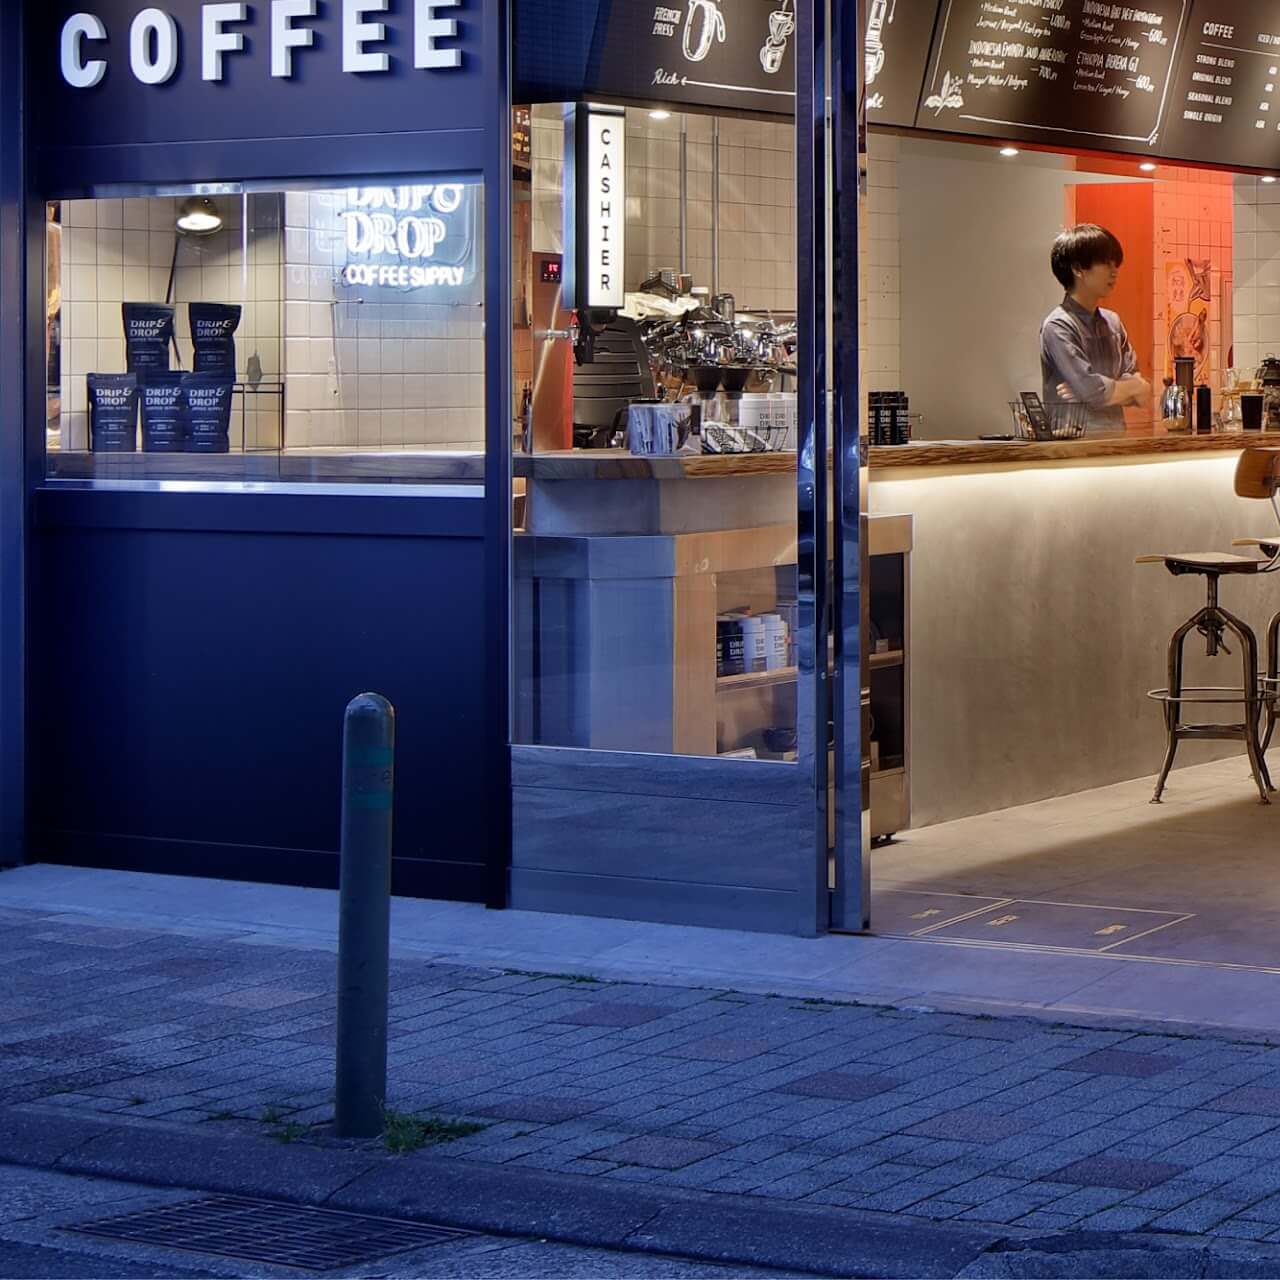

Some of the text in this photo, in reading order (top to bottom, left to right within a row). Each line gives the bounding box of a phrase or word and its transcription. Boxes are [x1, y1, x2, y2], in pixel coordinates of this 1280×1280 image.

[653, 6, 683, 25] FRENCH
[652, 22, 675, 37] PRESS
[1203, 22, 1235, 39] COFFEE
[651, 68, 681, 87] Rich
[600, 128, 612, 291] CASHIER
[342, 211, 447, 258] DROP
[345, 263, 409, 287] COFFEE
[129, 328, 160, 337] DROP
[96, 397, 128, 406] DROP
[145, 397, 177, 406] DROP
[188, 397, 220, 407] DROP
